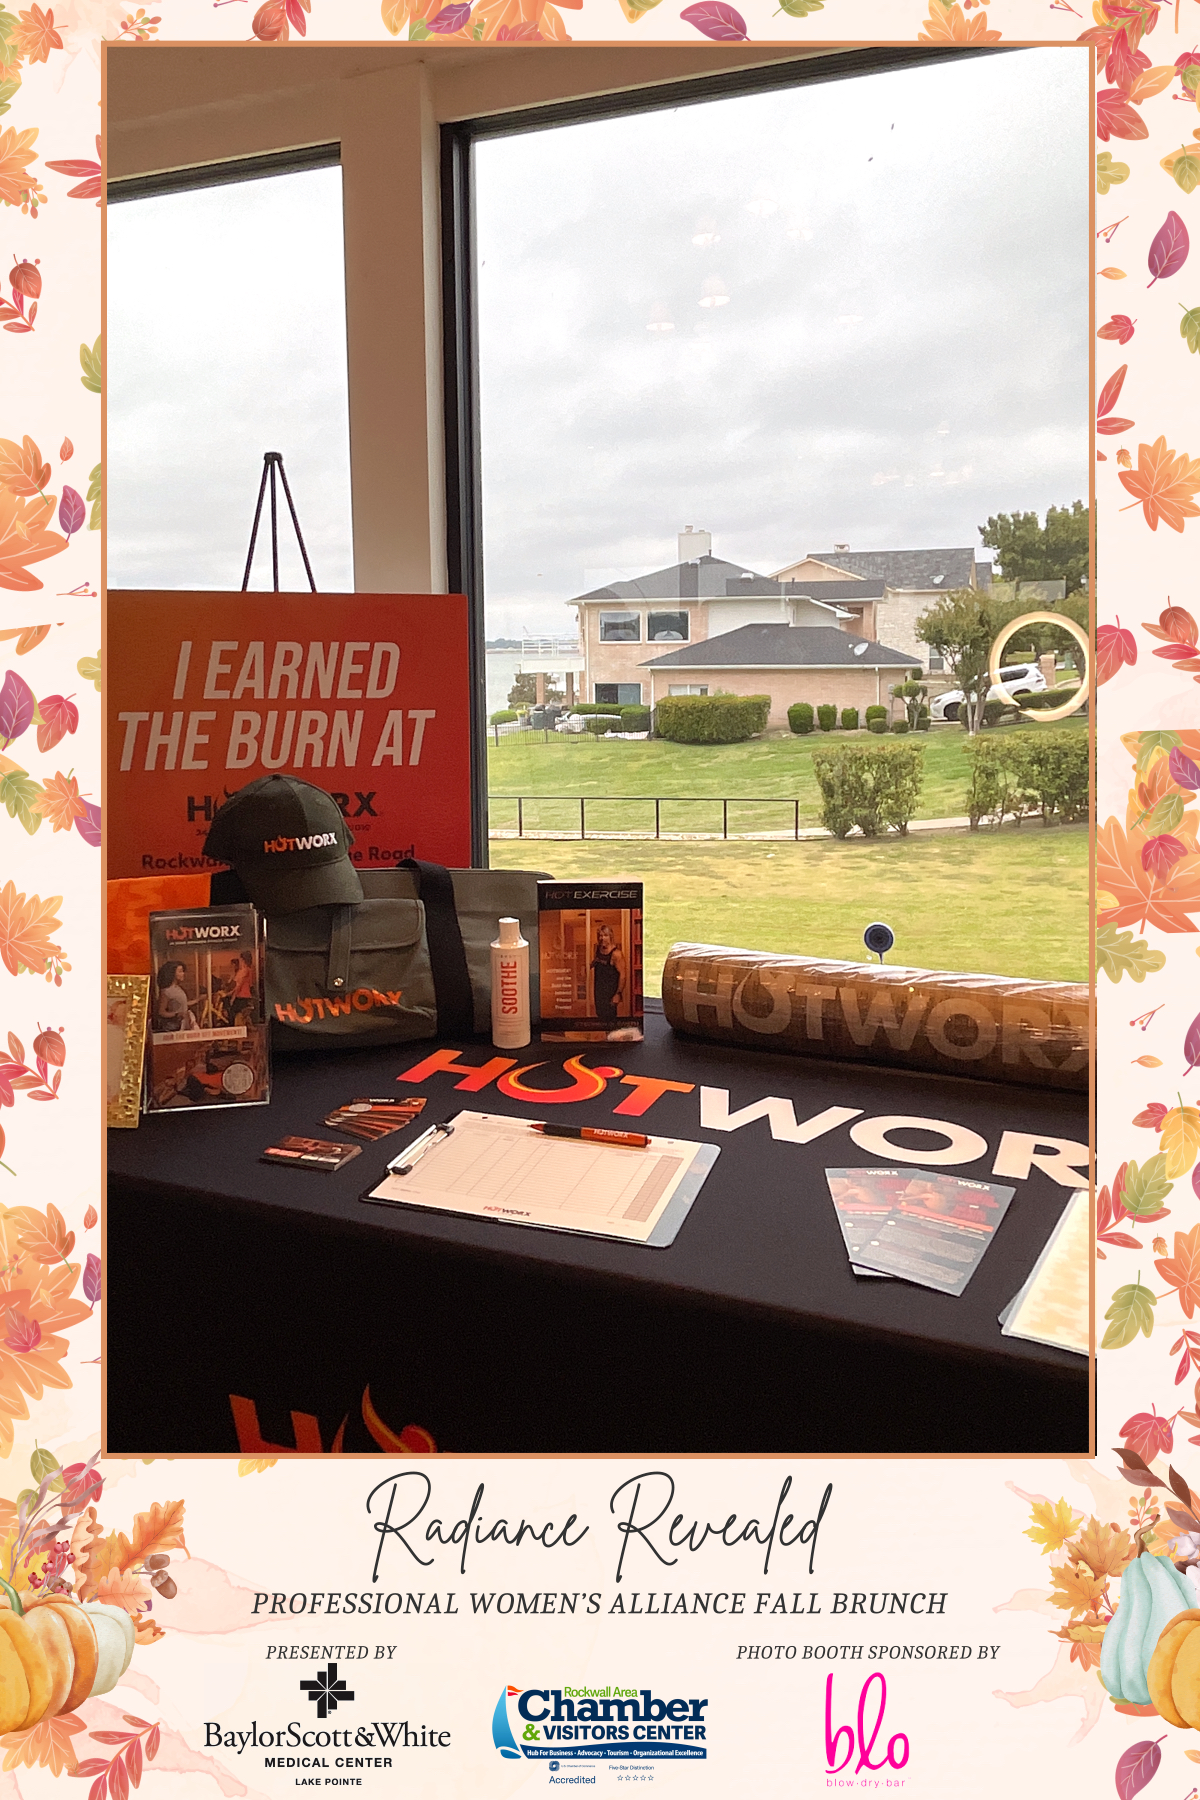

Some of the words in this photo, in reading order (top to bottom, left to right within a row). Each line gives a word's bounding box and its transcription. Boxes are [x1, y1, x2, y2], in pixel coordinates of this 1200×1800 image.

[172, 641, 192, 700] I
[203, 641, 400, 699] EARNED
[118, 711, 216, 771] THE
[225, 710, 364, 769] BURN
[372, 709, 436, 766] AT
[142, 852, 228, 869] Rockwa
[368, 844, 415, 860] Road
[263, 832, 338, 853] HOTWORX
[165, 925, 240, 940] HOTWORX
[274, 987, 403, 1024] HOTWORX
[500, 960, 518, 1015] SOOTHE
